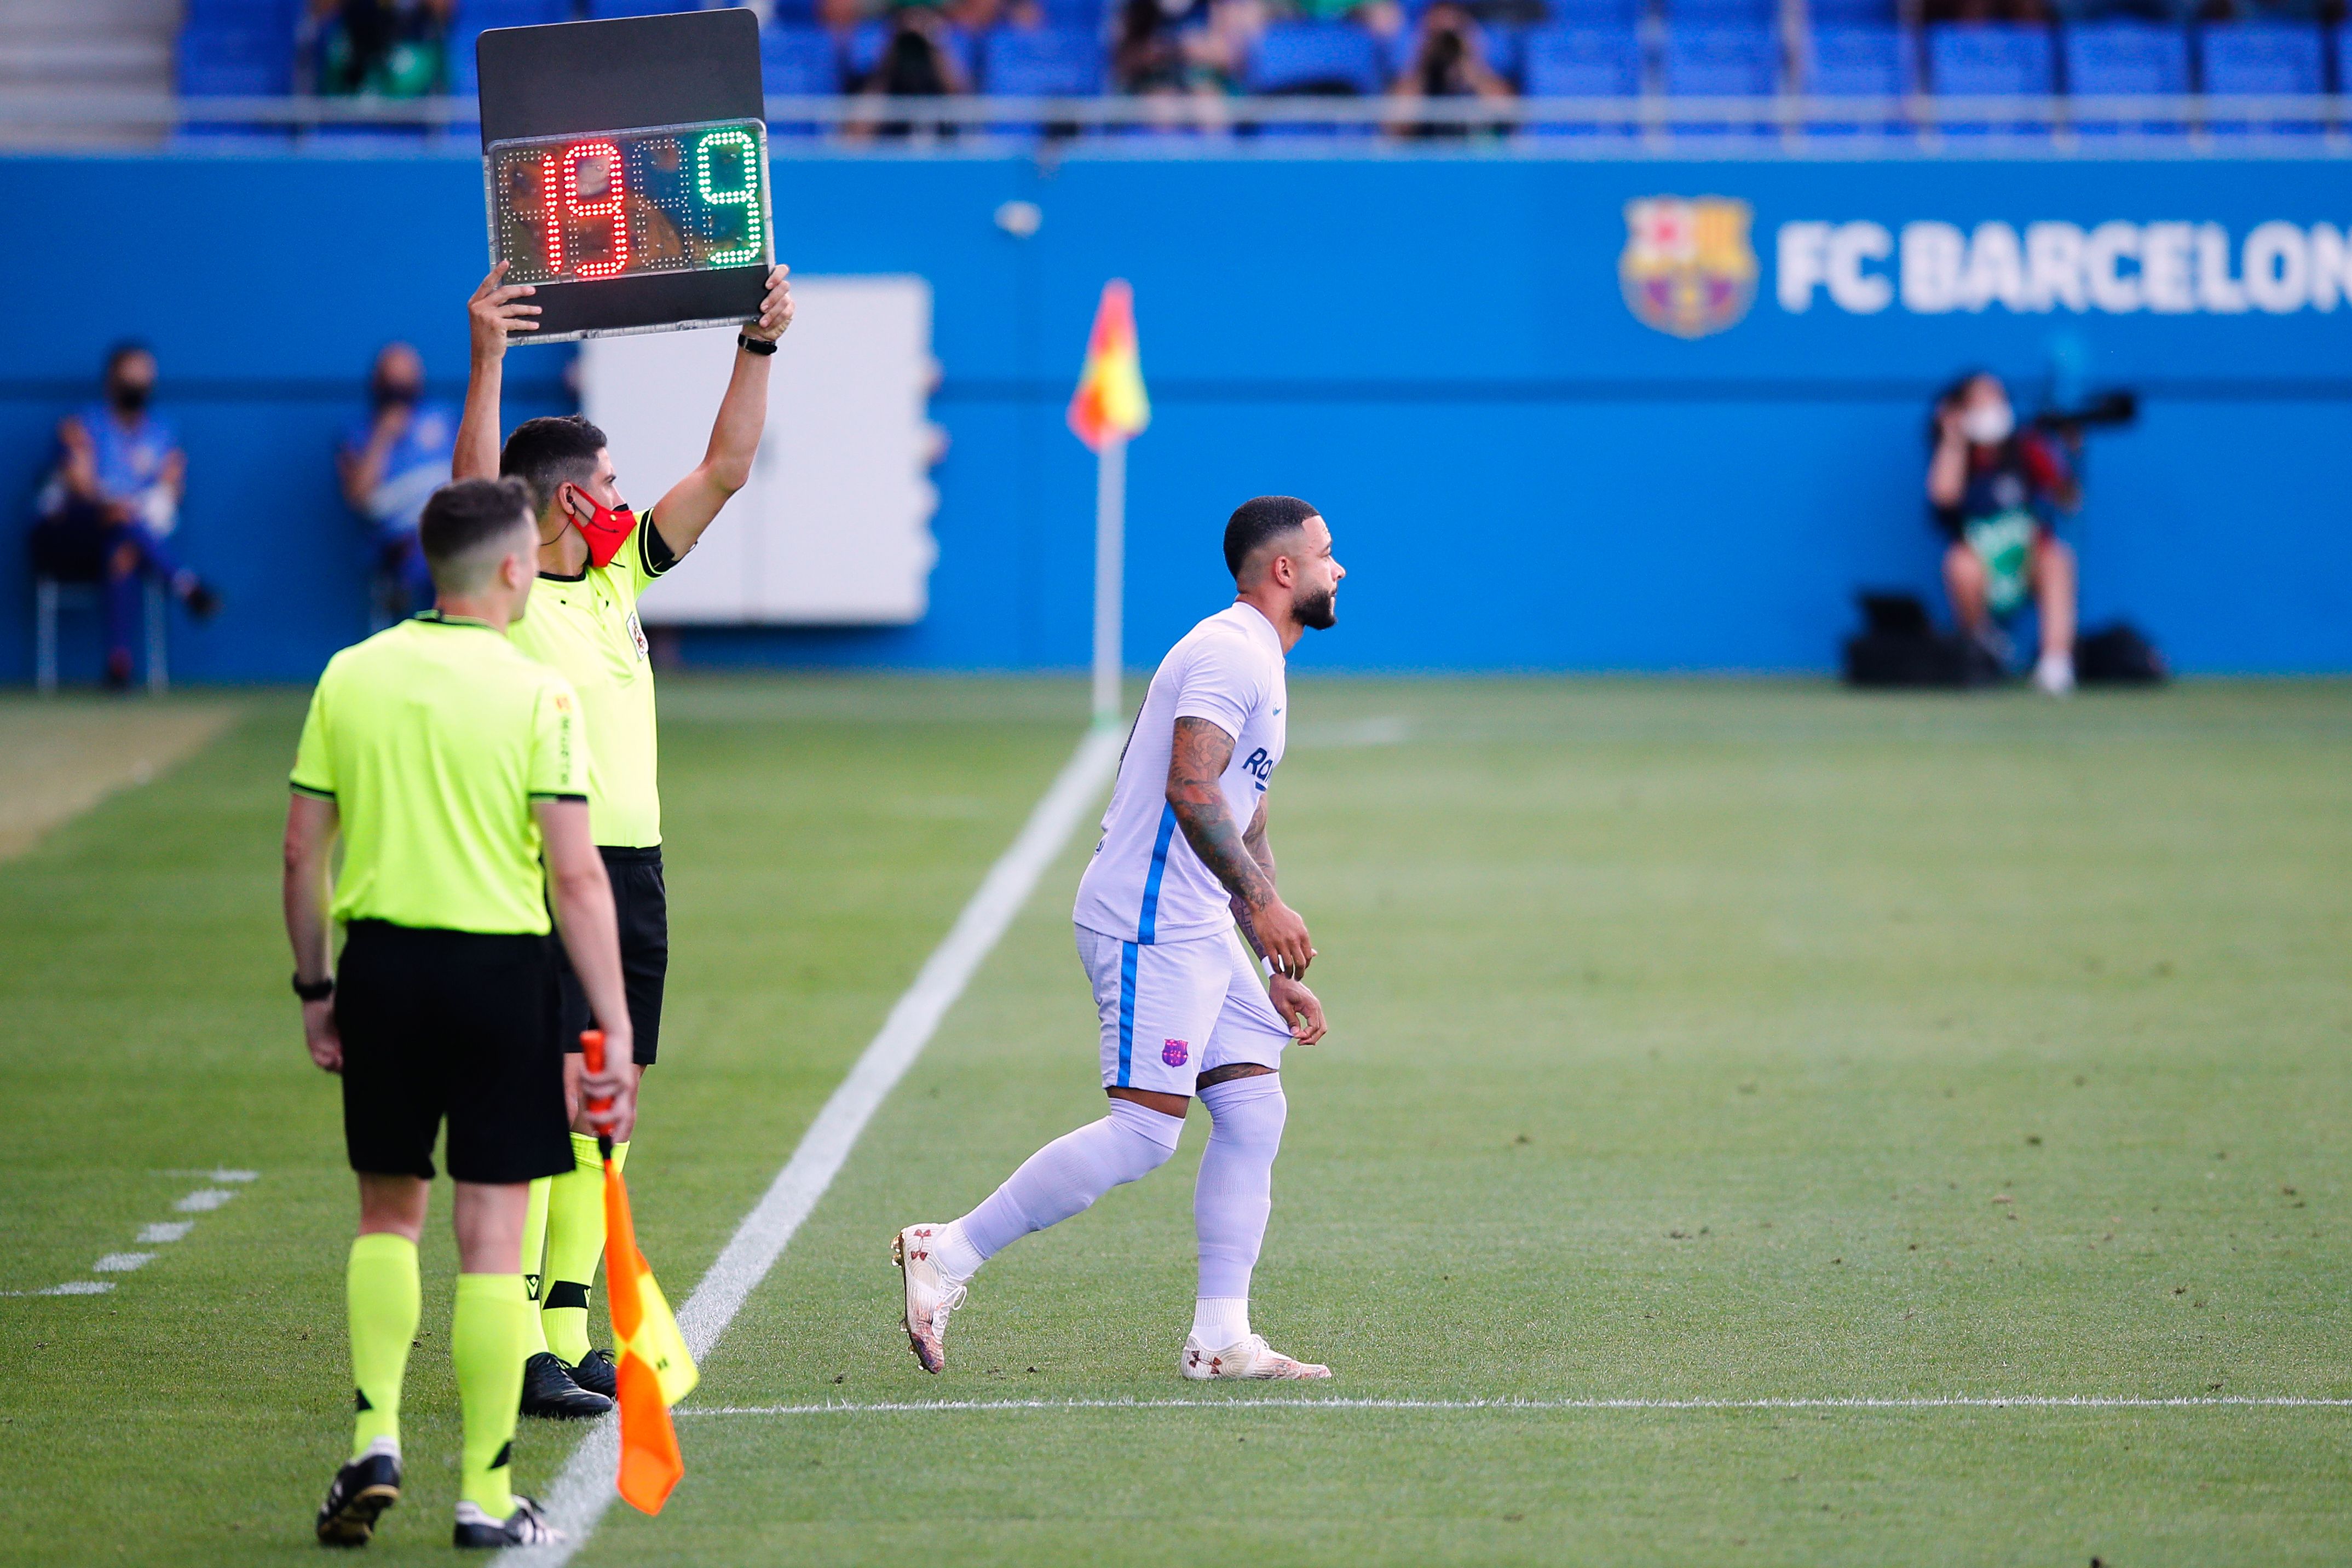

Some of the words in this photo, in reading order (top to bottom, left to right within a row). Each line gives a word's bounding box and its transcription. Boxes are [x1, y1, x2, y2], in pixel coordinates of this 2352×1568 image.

[543, 142, 628, 276] 19
[696, 130, 762, 265] 9
[1775, 221, 1892, 313] FC
[1899, 221, 2352, 313] BARCELON
[1241, 747, 1273, 782] Ra
